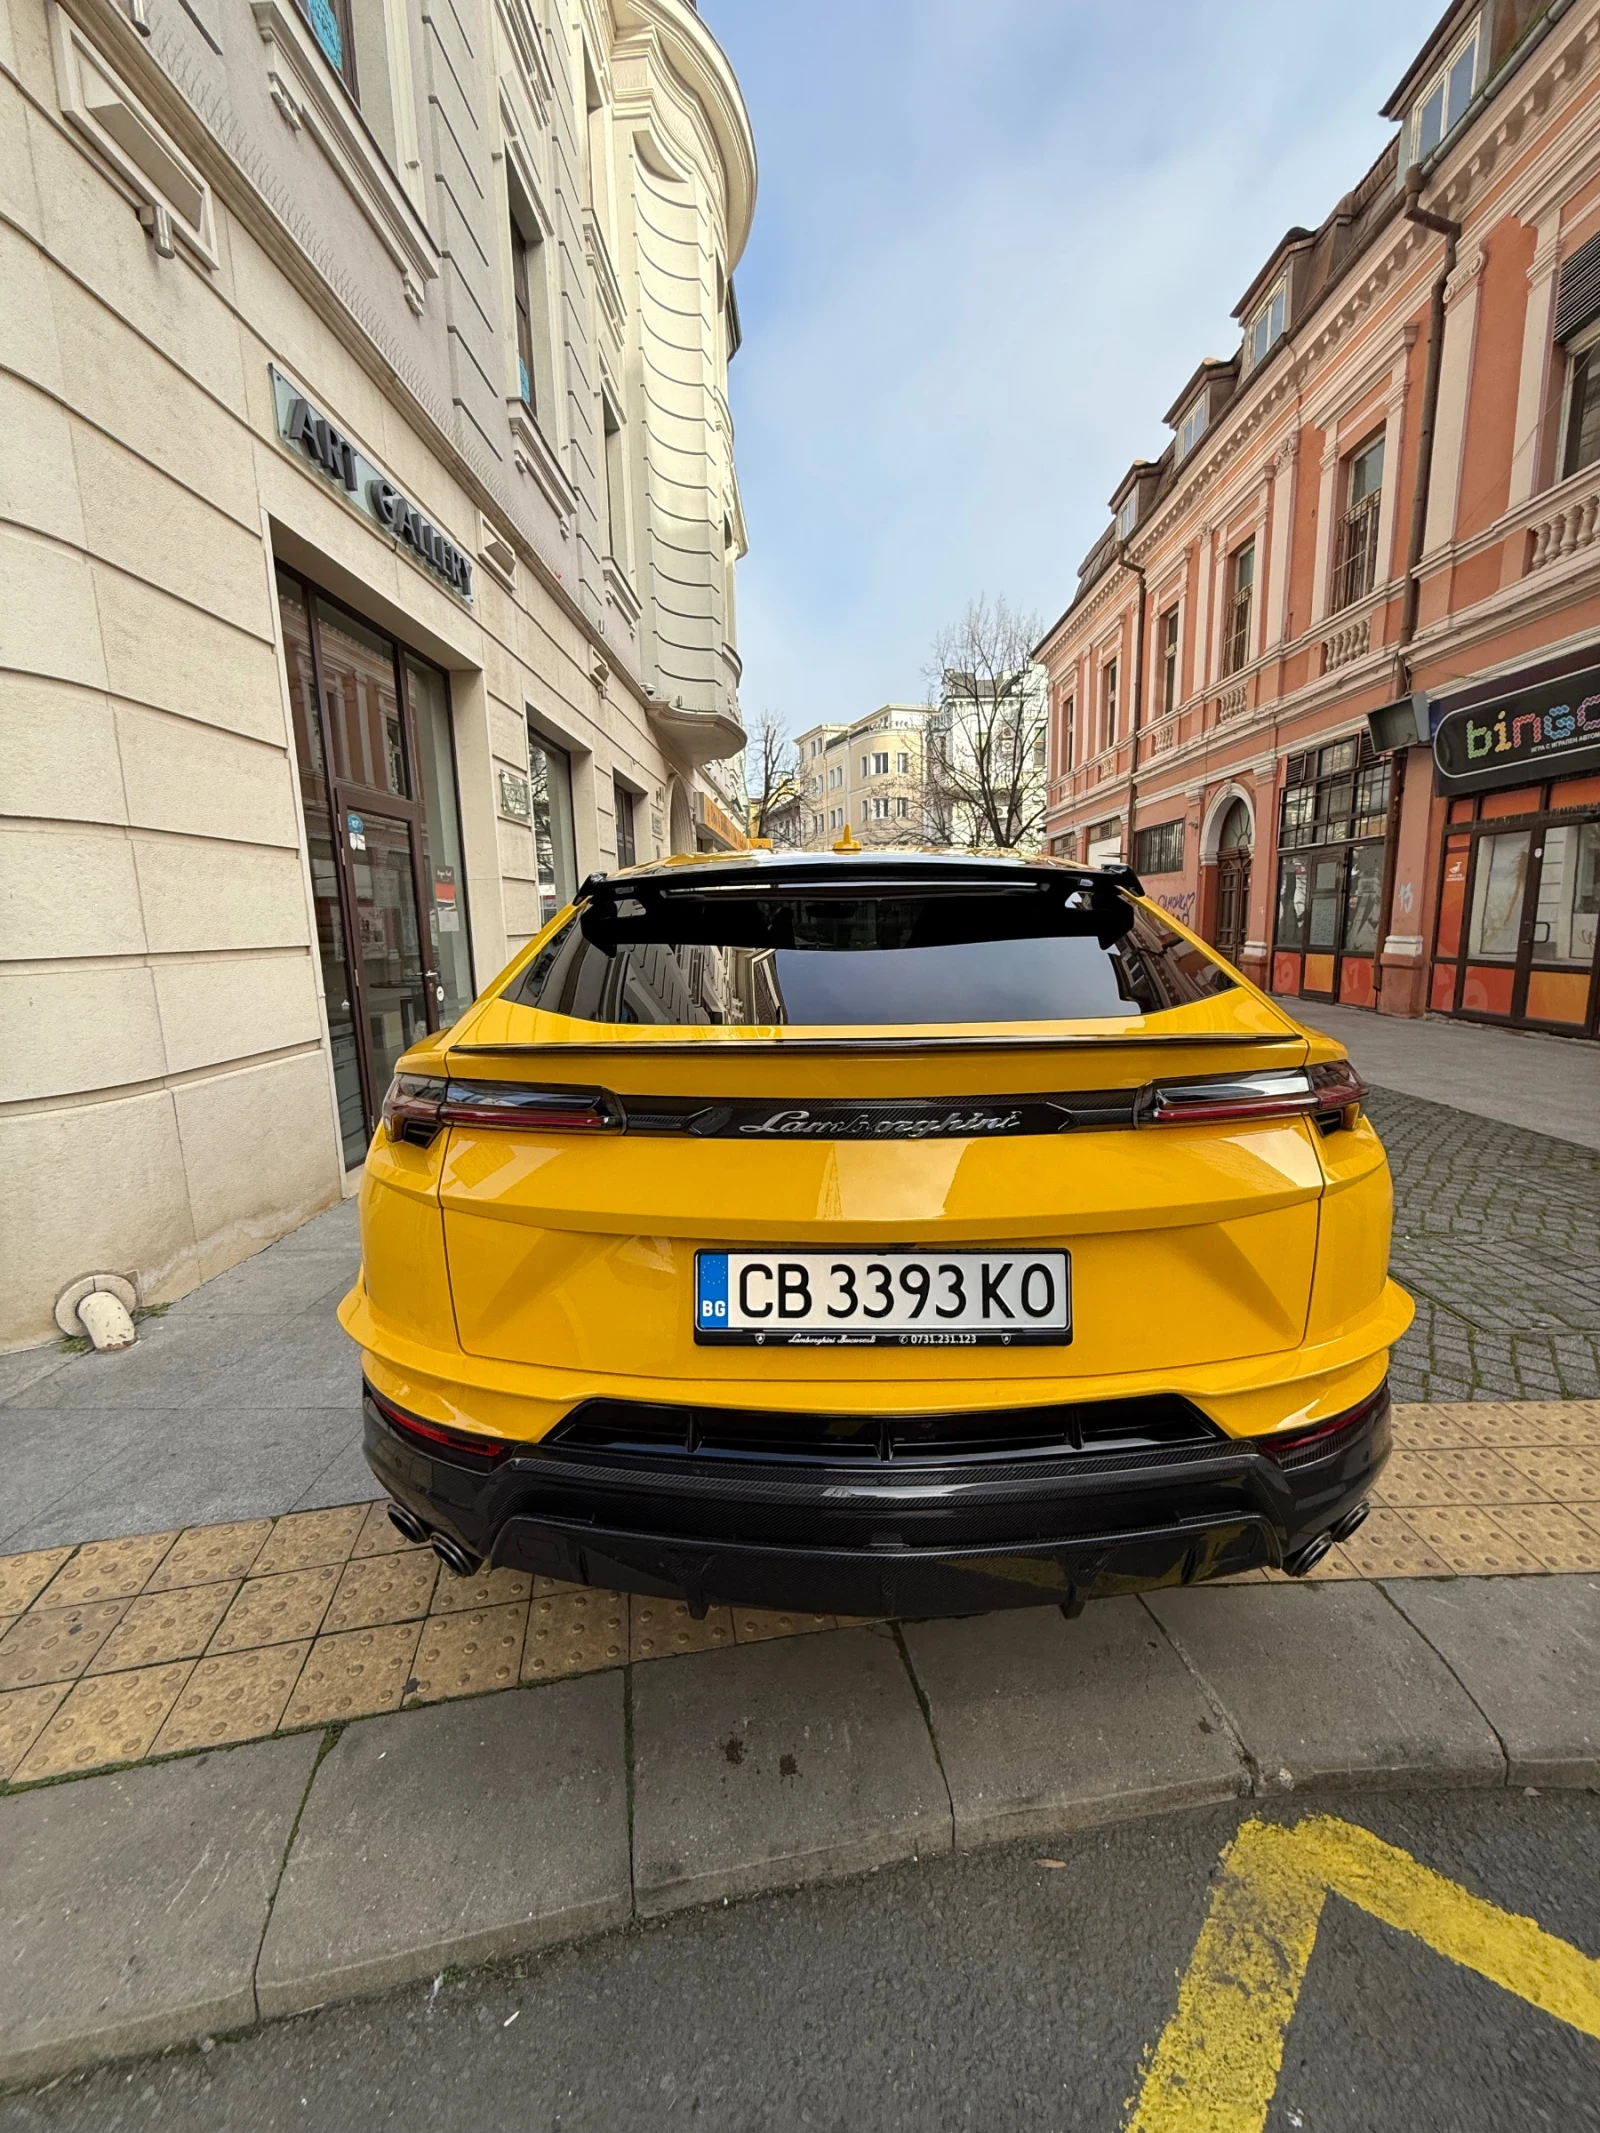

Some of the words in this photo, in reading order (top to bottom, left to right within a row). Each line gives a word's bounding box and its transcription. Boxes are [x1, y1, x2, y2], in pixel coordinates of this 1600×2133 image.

[288, 398, 358, 491] ART
[367, 479, 473, 596] GALLERY
[739, 1110, 1022, 1137] Lamborghini
[739, 1263, 812, 1318] CB
[826, 1263, 967, 1318] 3393
[702, 1300, 726, 1317] BG
[788, 1333, 835, 1345] Lamborghini
[911, 1334, 977, 1344] 0731.231.123
